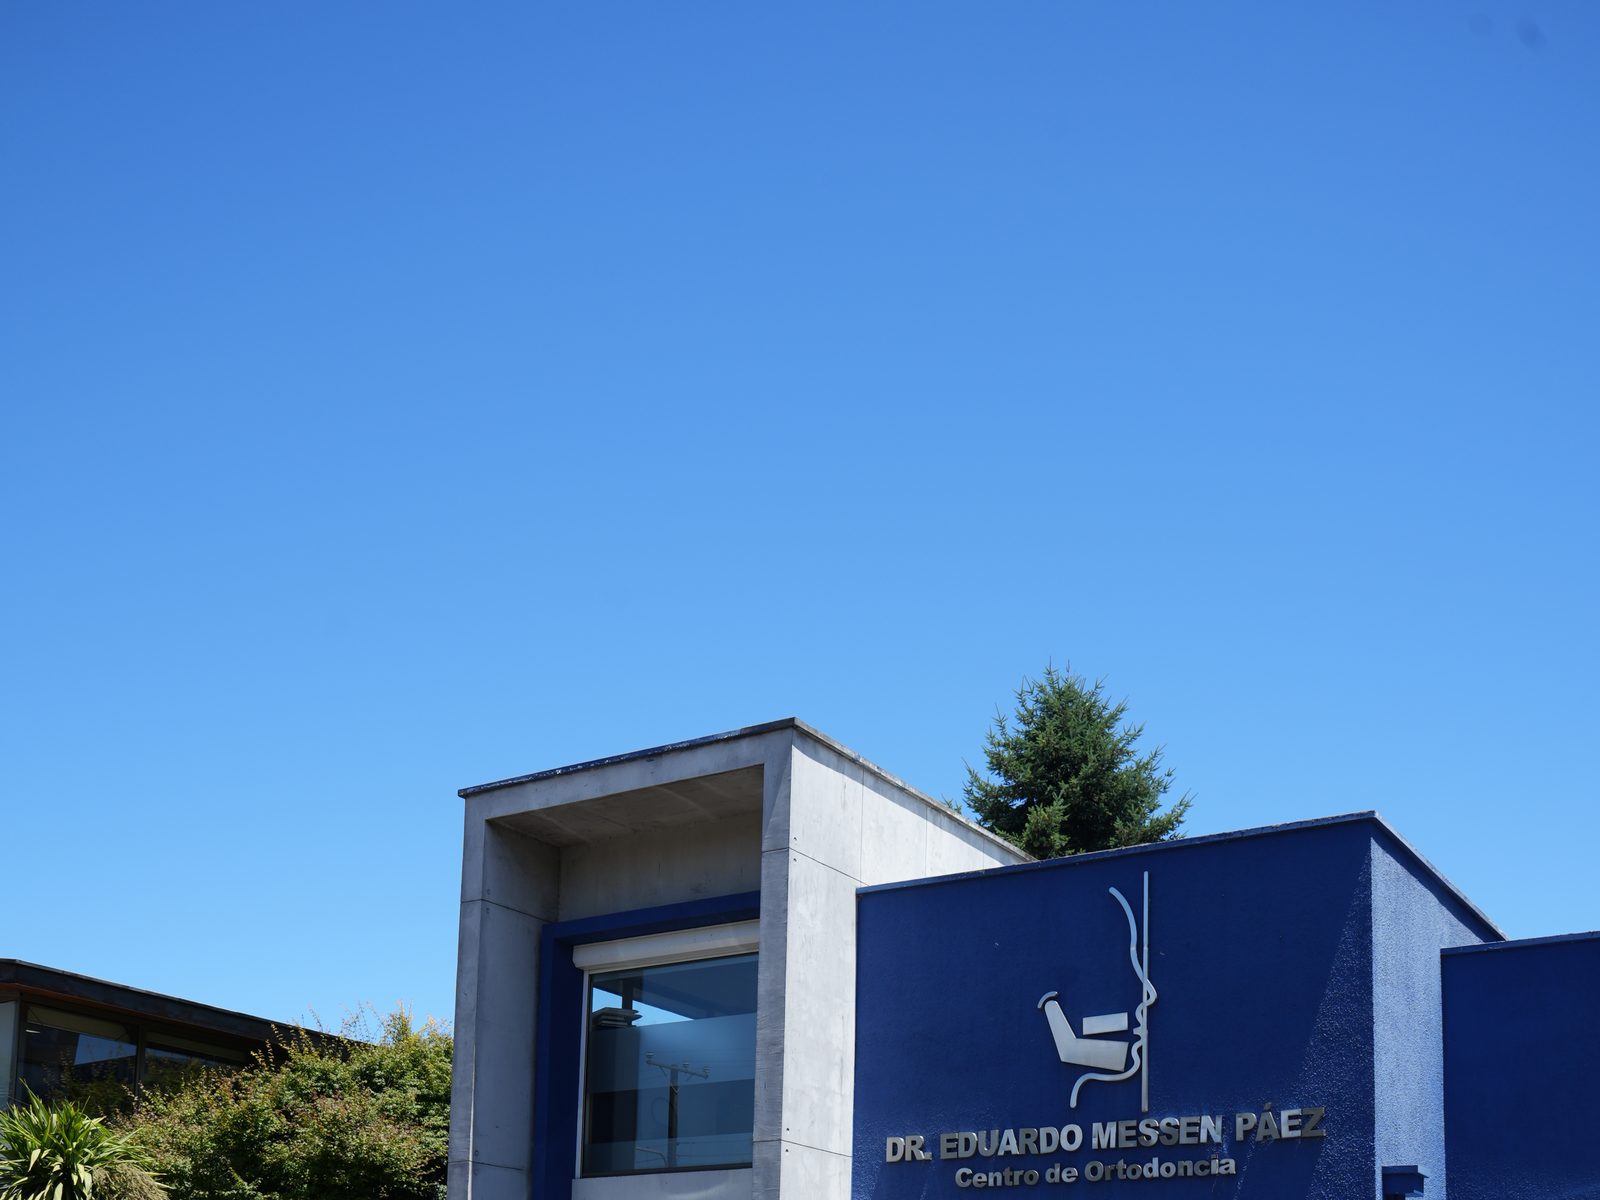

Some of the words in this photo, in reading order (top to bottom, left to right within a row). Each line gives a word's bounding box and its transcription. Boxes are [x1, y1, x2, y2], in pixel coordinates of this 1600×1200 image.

[885, 1135, 932, 1163] DR.
[940, 1123, 1083, 1160] EDUARDO
[1092, 1115, 1222, 1150] MESSEN
[1235, 1102, 1327, 1142] PÁEZ
[954, 1166, 1040, 1188] Centro
[1044, 1163, 1079, 1184] de
[1084, 1153, 1237, 1182] Ortodoncia
